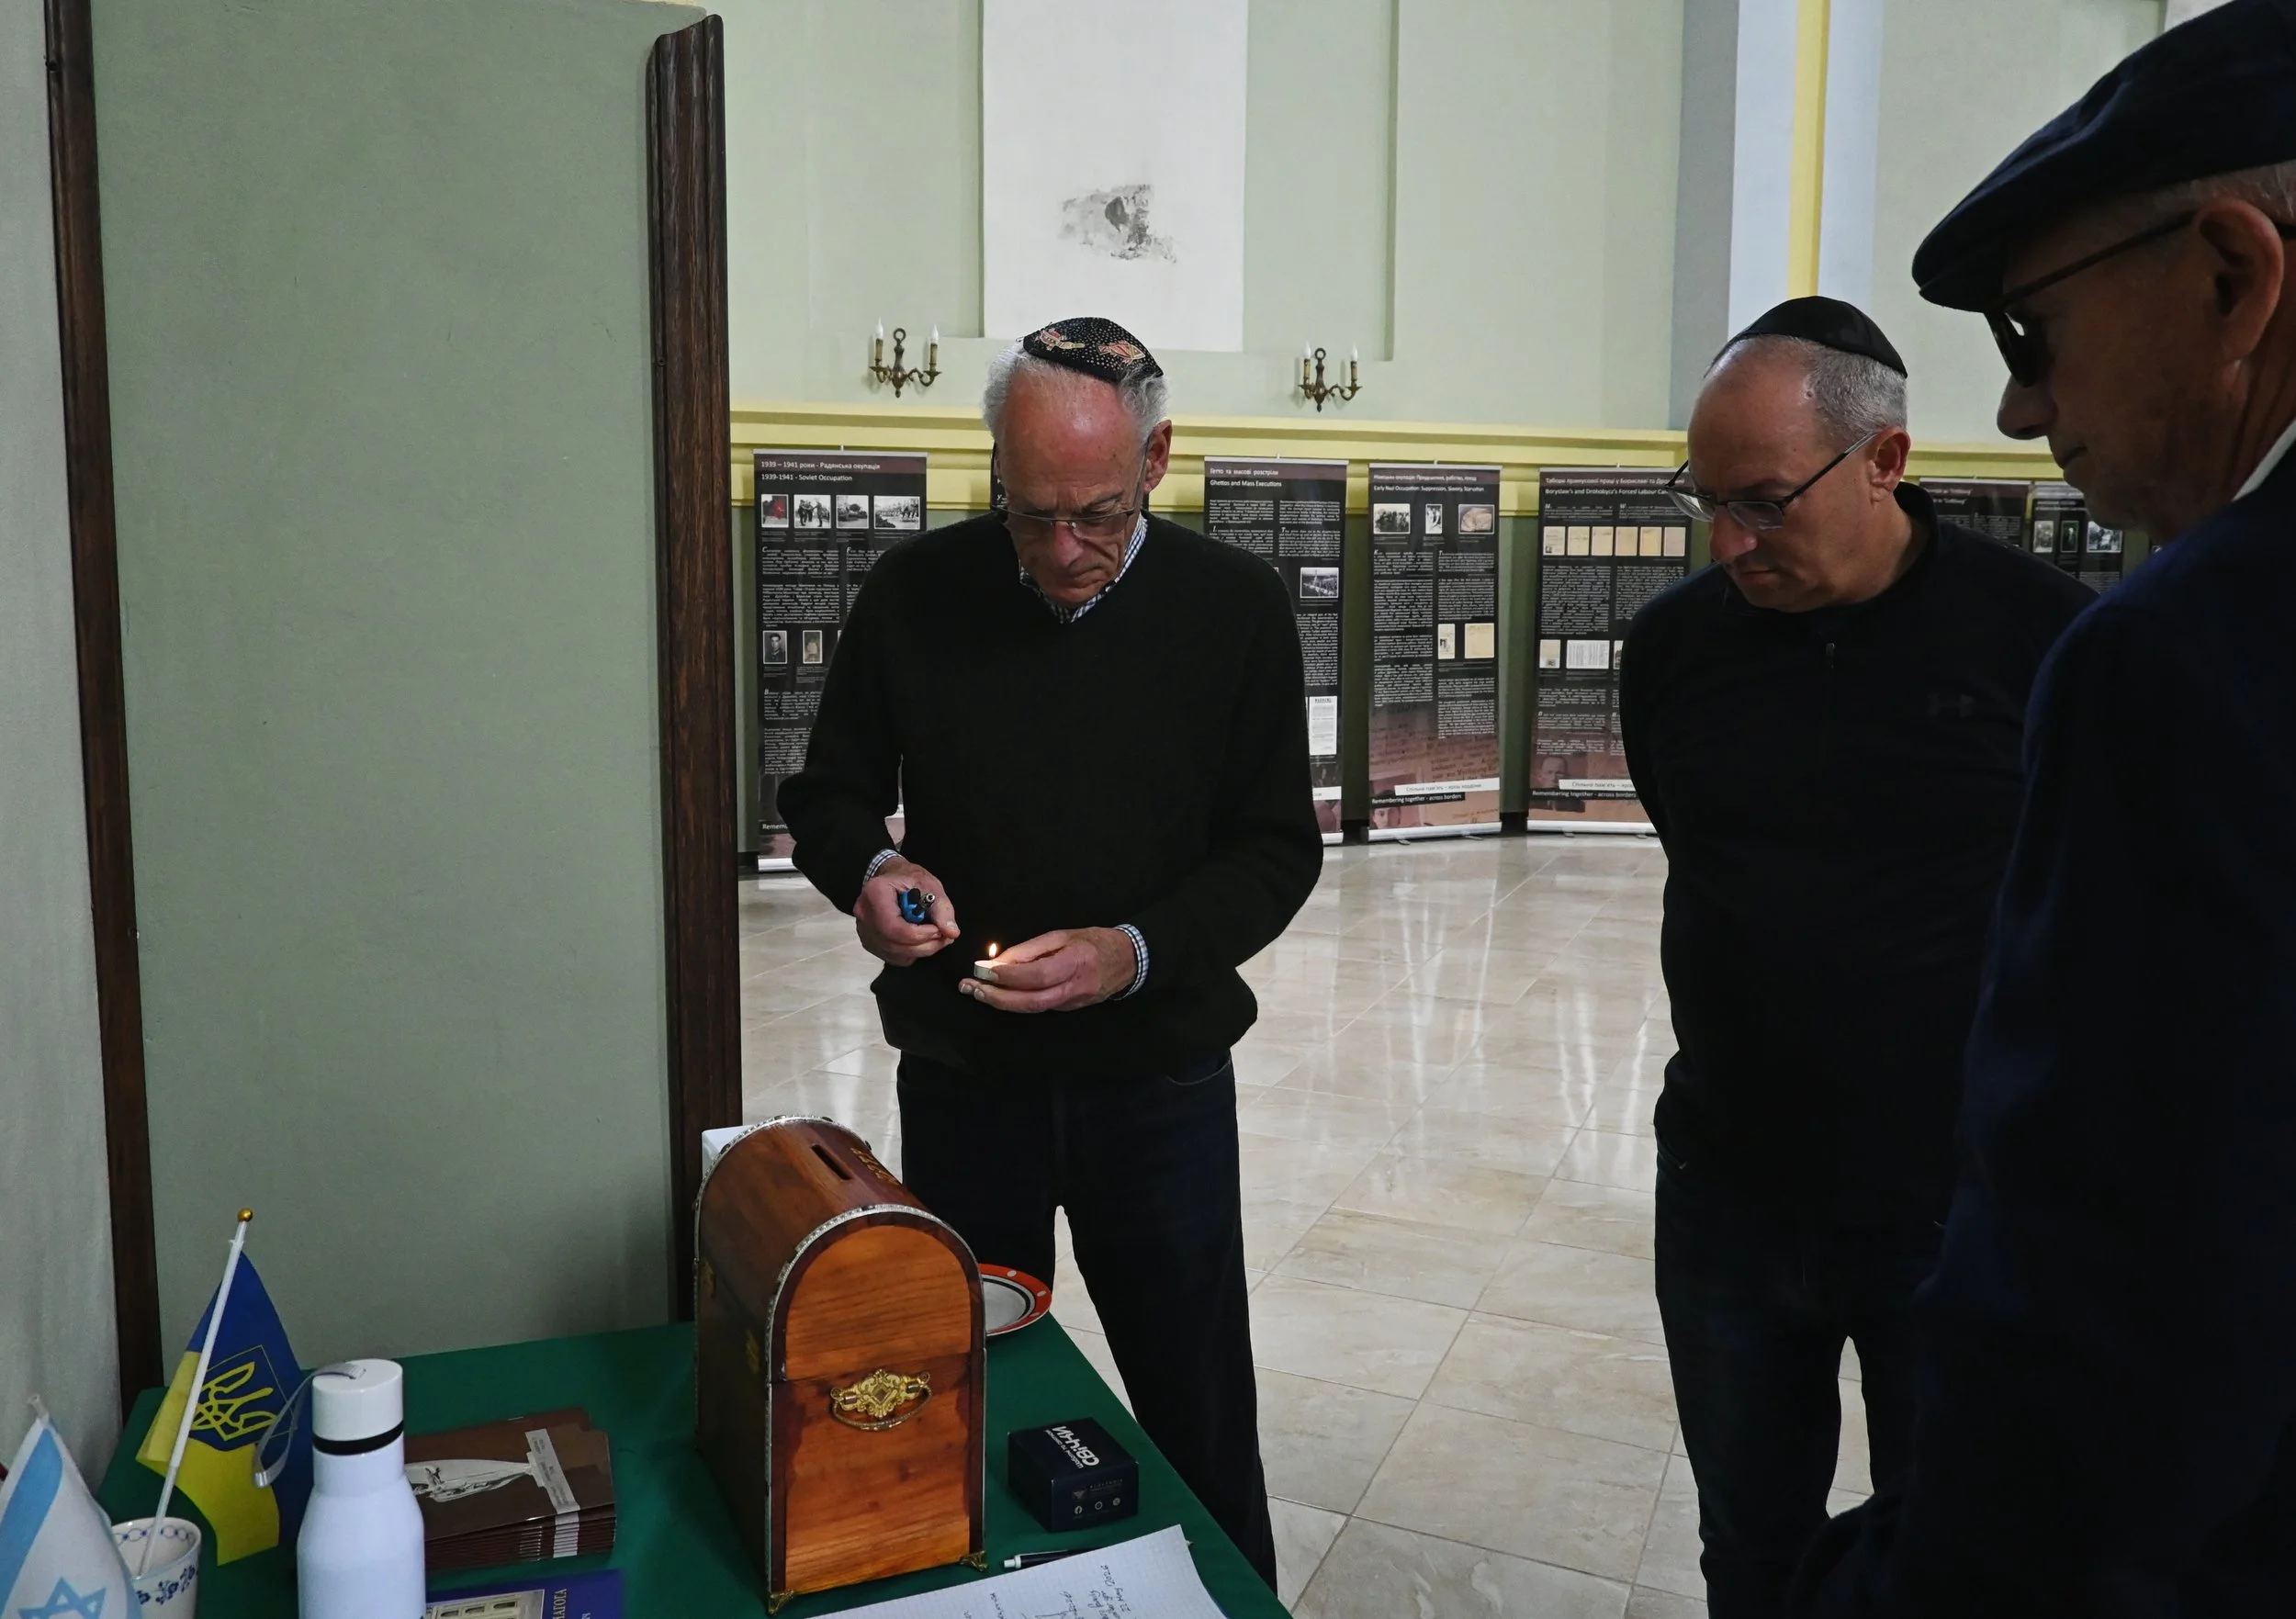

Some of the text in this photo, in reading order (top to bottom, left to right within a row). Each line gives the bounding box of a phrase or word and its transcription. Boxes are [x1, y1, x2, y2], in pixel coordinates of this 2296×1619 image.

[819, 462, 852, 470] Радянська
[818, 474, 853, 482] Occupation
[1404, 795, 1425, 804] together
